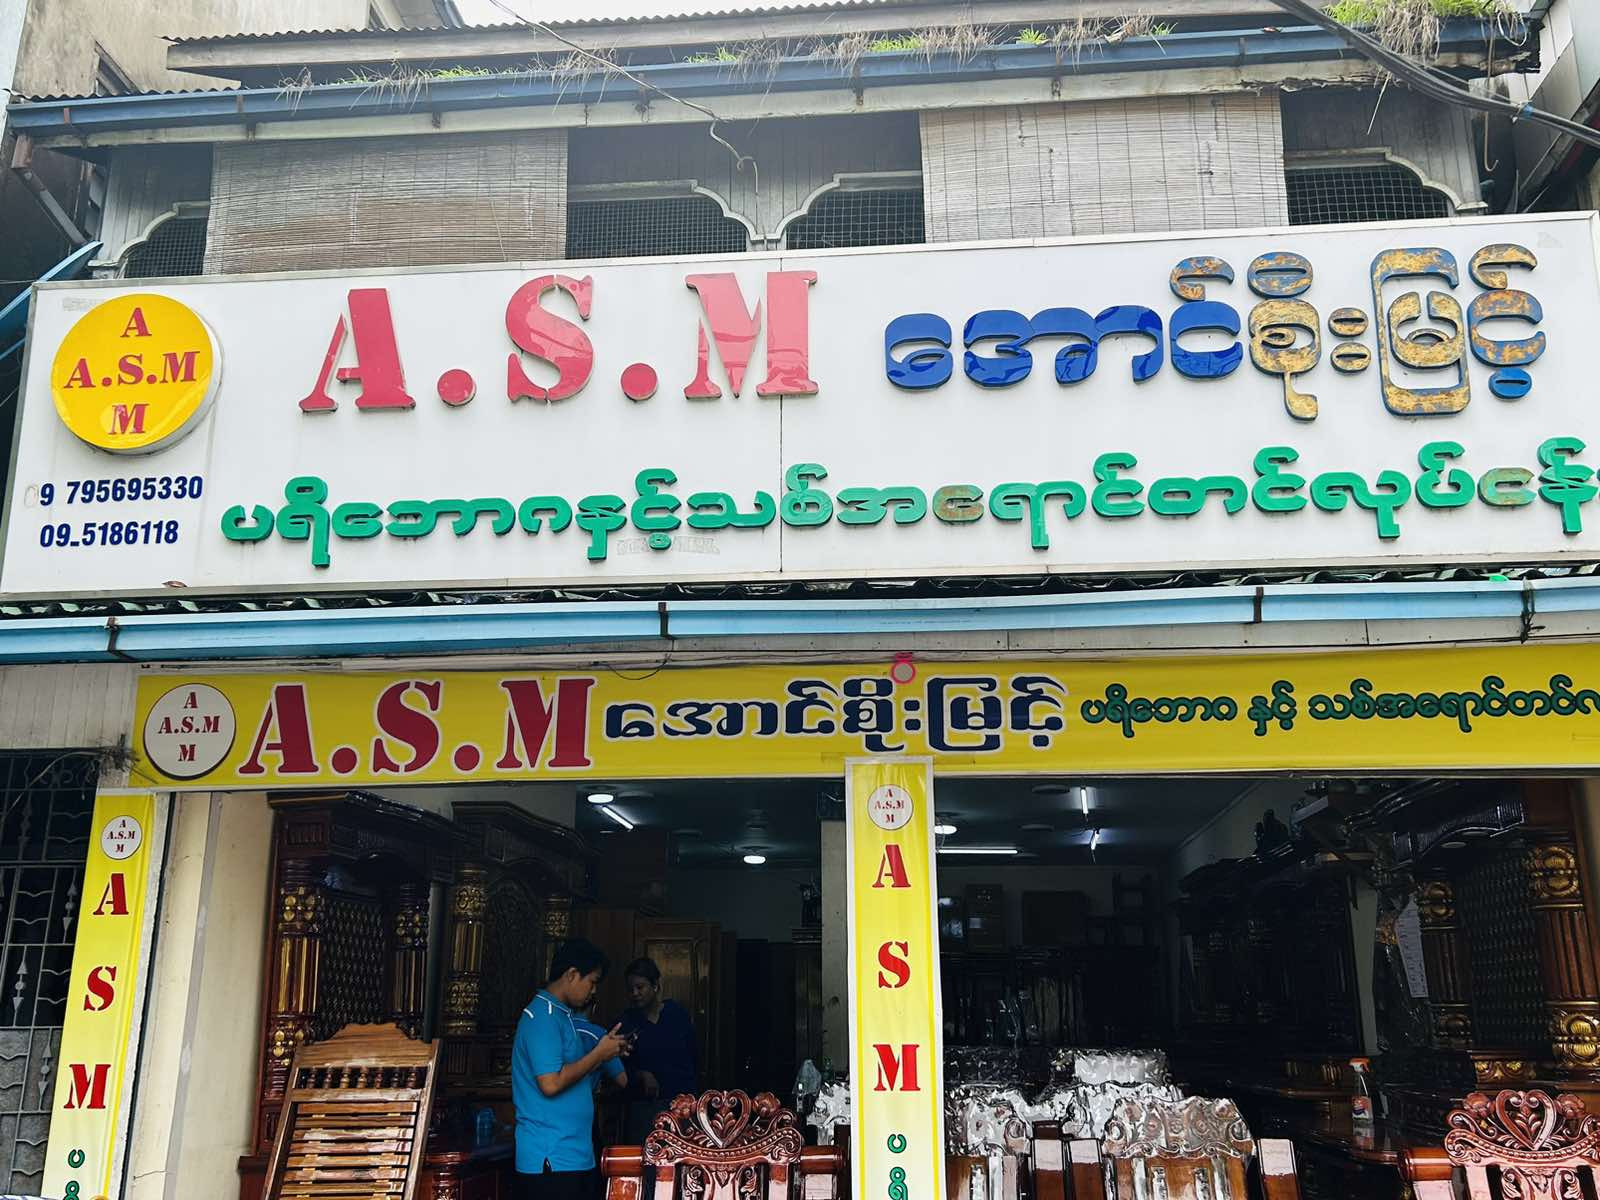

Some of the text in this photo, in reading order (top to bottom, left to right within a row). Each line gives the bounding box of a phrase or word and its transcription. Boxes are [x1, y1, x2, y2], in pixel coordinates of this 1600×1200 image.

[120, 307, 152, 338] A
[299, 270, 819, 412] A.S.M
[64, 351, 200, 388] A.S.M
[109, 403, 149, 435] M
[67, 476, 203, 504] 795695330
[221, 437, 1600, 567] ပရိဘောဂနှင့်သစ်အရောင်တင်လုပ်ငန်
[184, 692, 198, 709] A
[1081, 683, 1238, 738] ပရိဘောဂ
[158, 715, 220, 734] A.S.M
[238, 678, 596, 774] A.S.M
[177, 744, 196, 762] M
[874, 800, 905, 810] A.S.M
[104, 830, 136, 840] A.S.M
